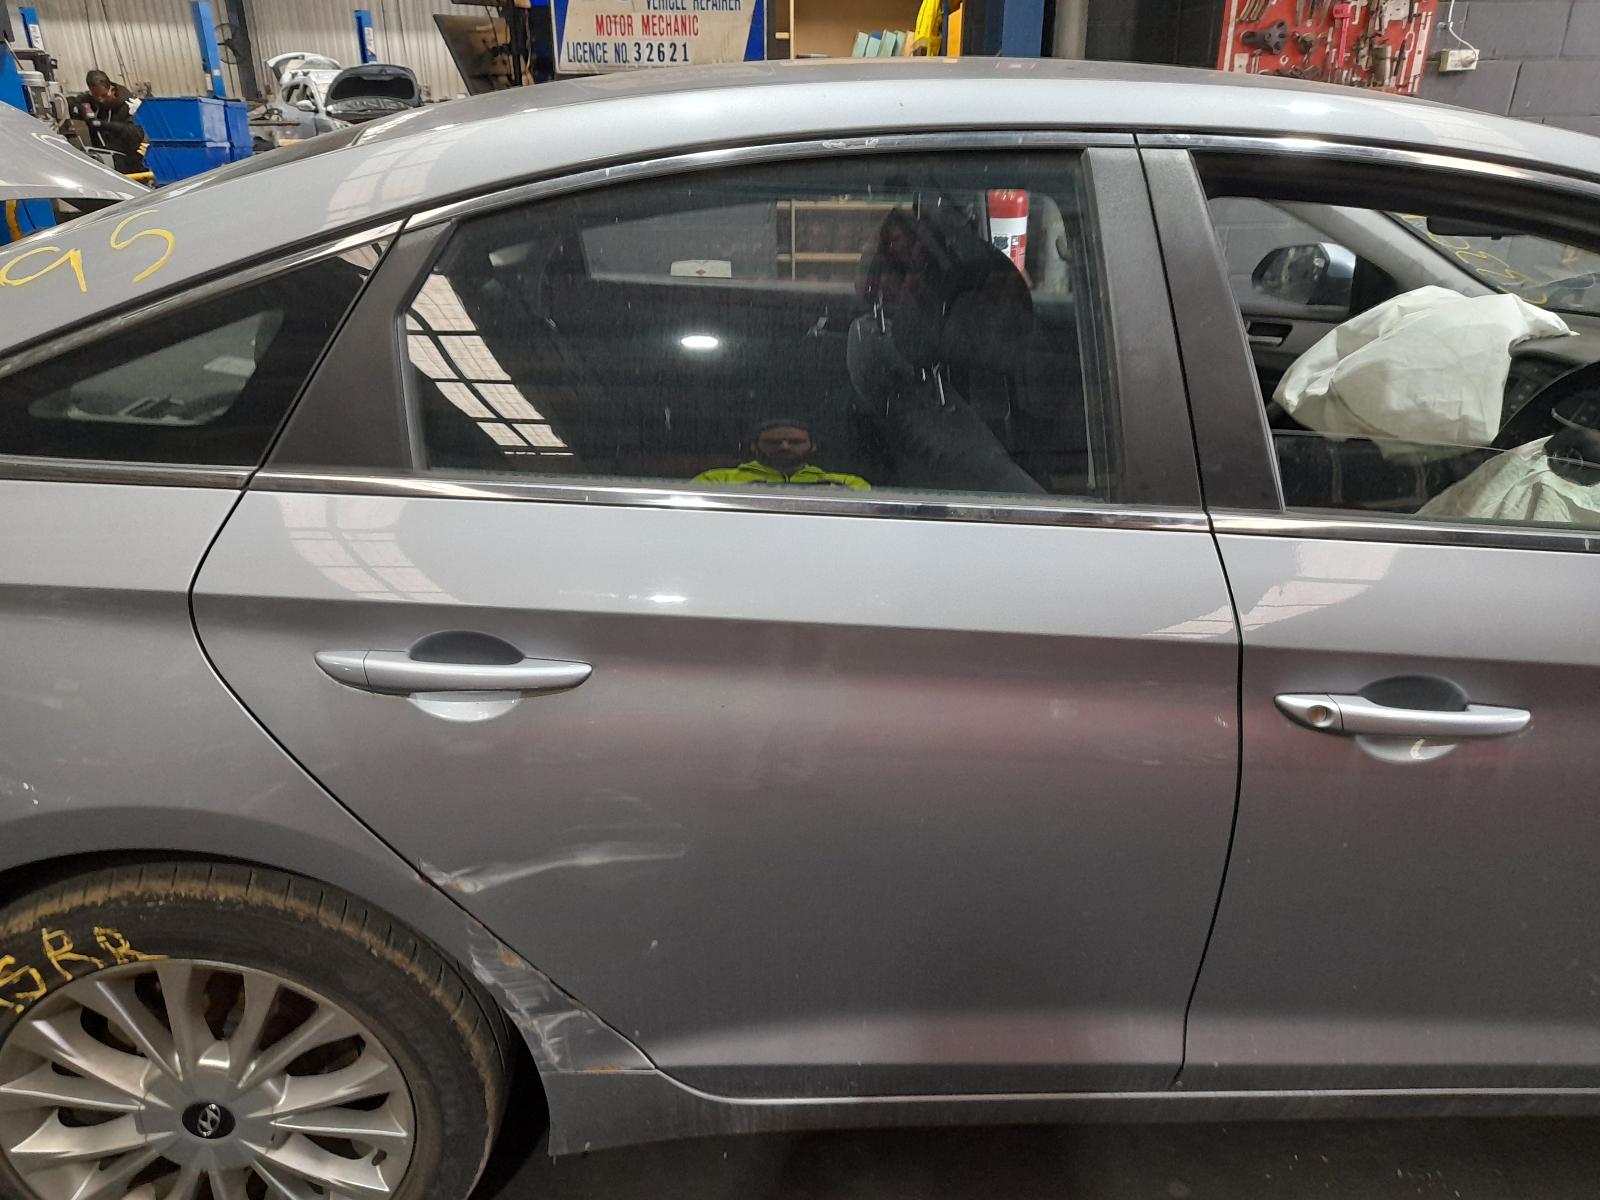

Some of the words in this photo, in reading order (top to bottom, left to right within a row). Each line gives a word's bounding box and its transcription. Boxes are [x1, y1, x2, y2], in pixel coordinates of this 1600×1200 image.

[595, 14, 634, 37] MOTOR
[641, 15, 699, 37] MECHANIC
[567, 42, 608, 63] LICENCE
[633, 42, 690, 62] 32621
